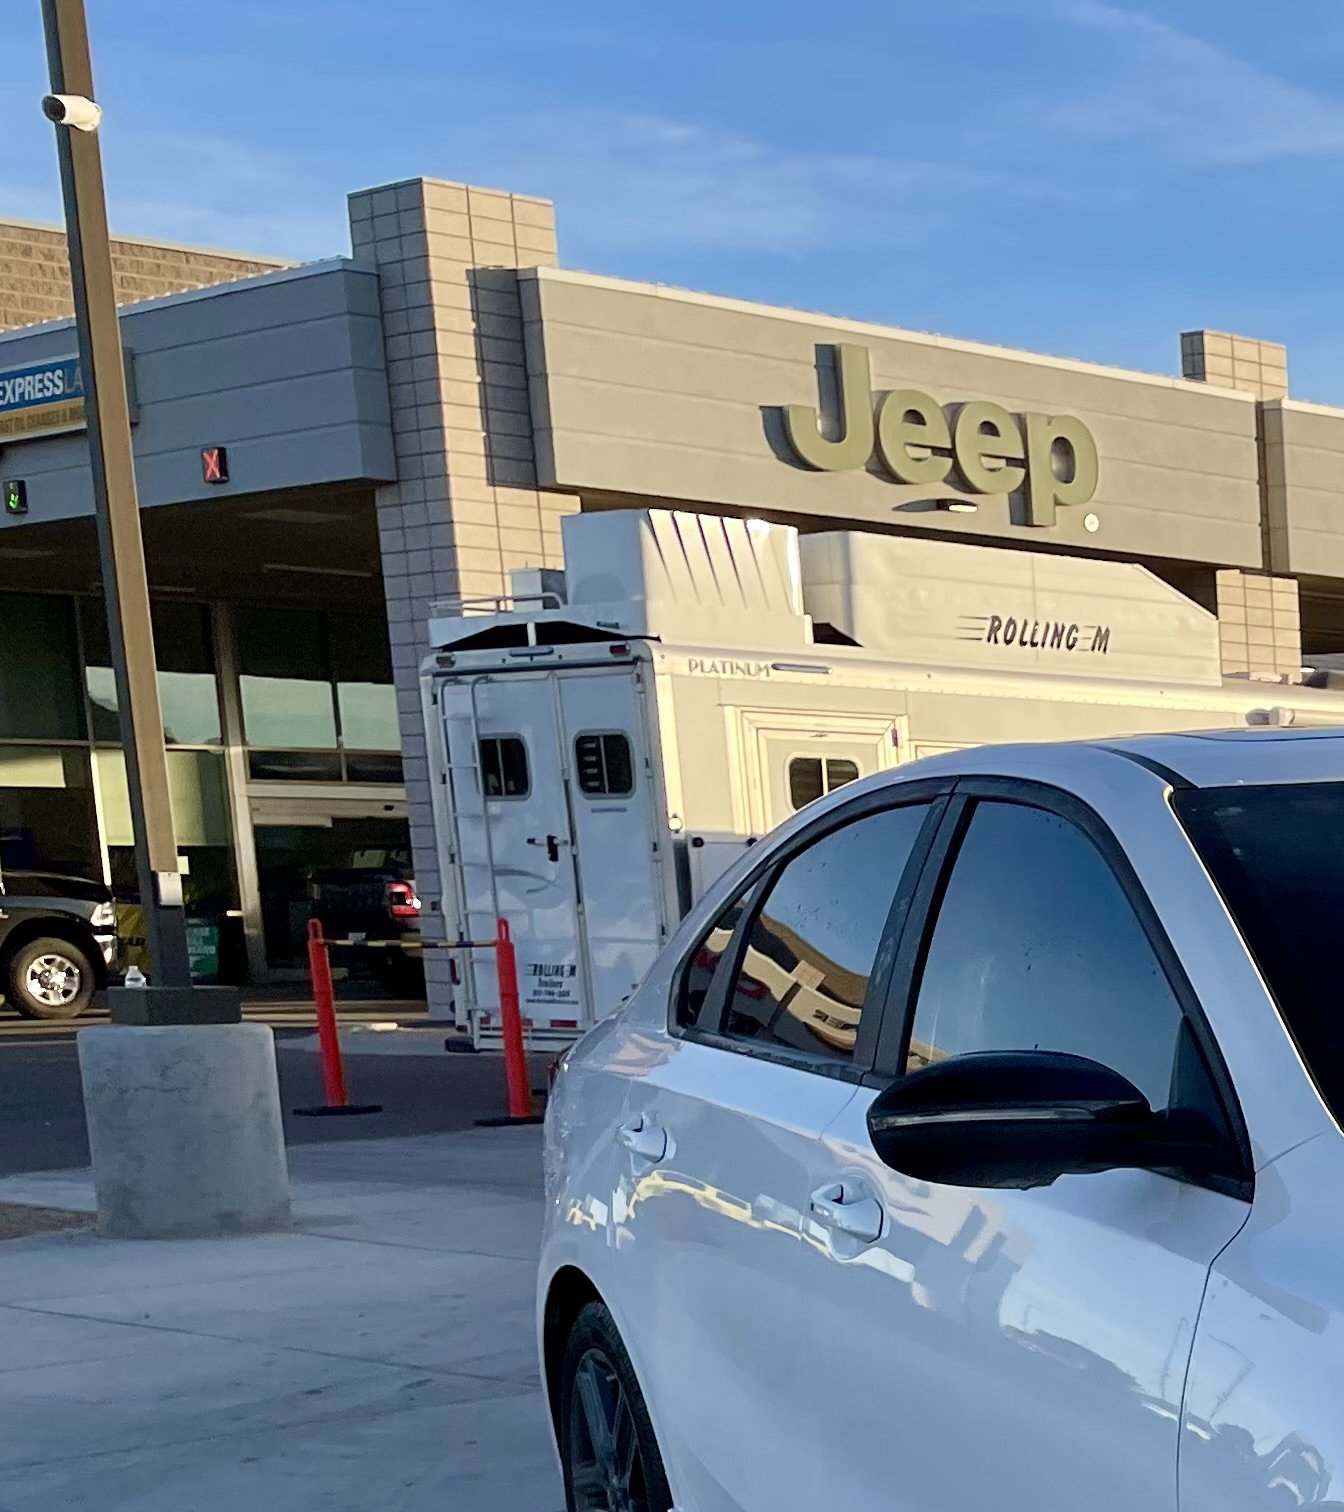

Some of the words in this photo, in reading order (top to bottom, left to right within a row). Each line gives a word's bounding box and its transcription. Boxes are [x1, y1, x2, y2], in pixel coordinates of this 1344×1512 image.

[0, 369, 64, 405] EXPRESS
[776, 343, 1099, 526] Jeep
[987, 615, 1080, 651] ROLLING
[1091, 625, 1111, 654] M
[688, 658, 771, 678] PLATINUM
